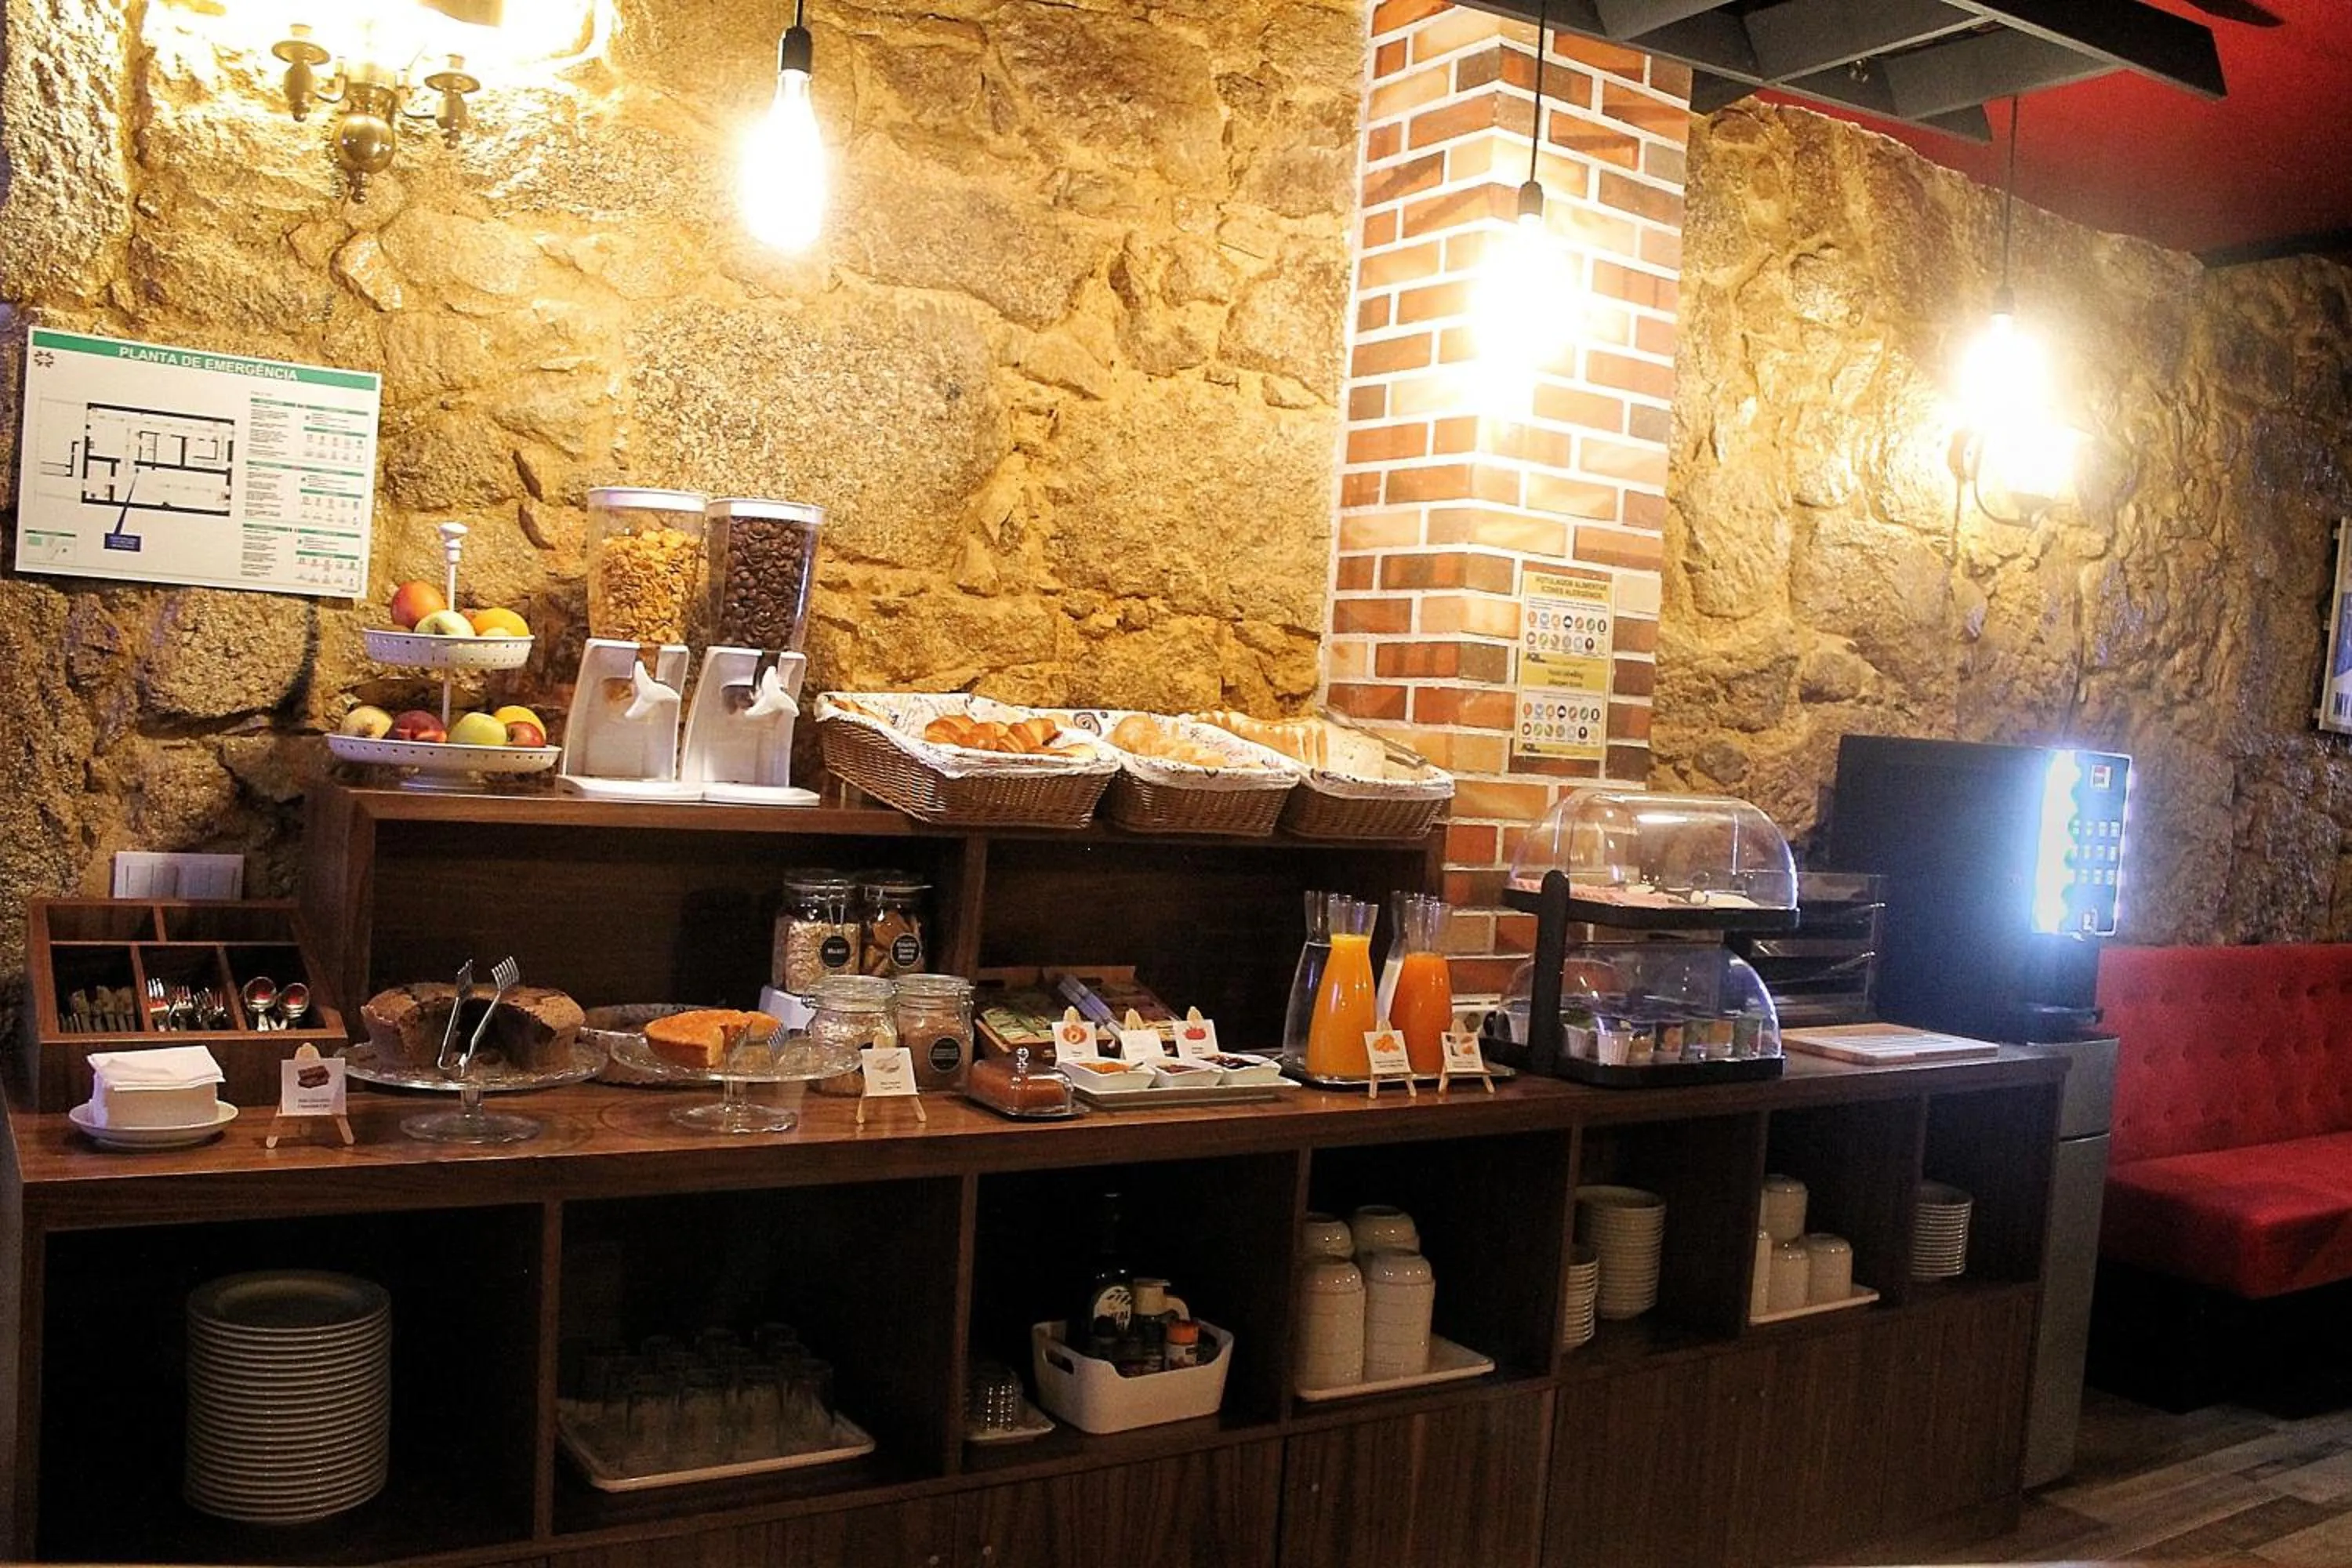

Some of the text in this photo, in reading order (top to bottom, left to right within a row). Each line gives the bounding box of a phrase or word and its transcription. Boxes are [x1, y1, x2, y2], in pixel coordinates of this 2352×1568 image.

[119, 346, 299, 381] PLANTA DE EMERGÊNCIA
